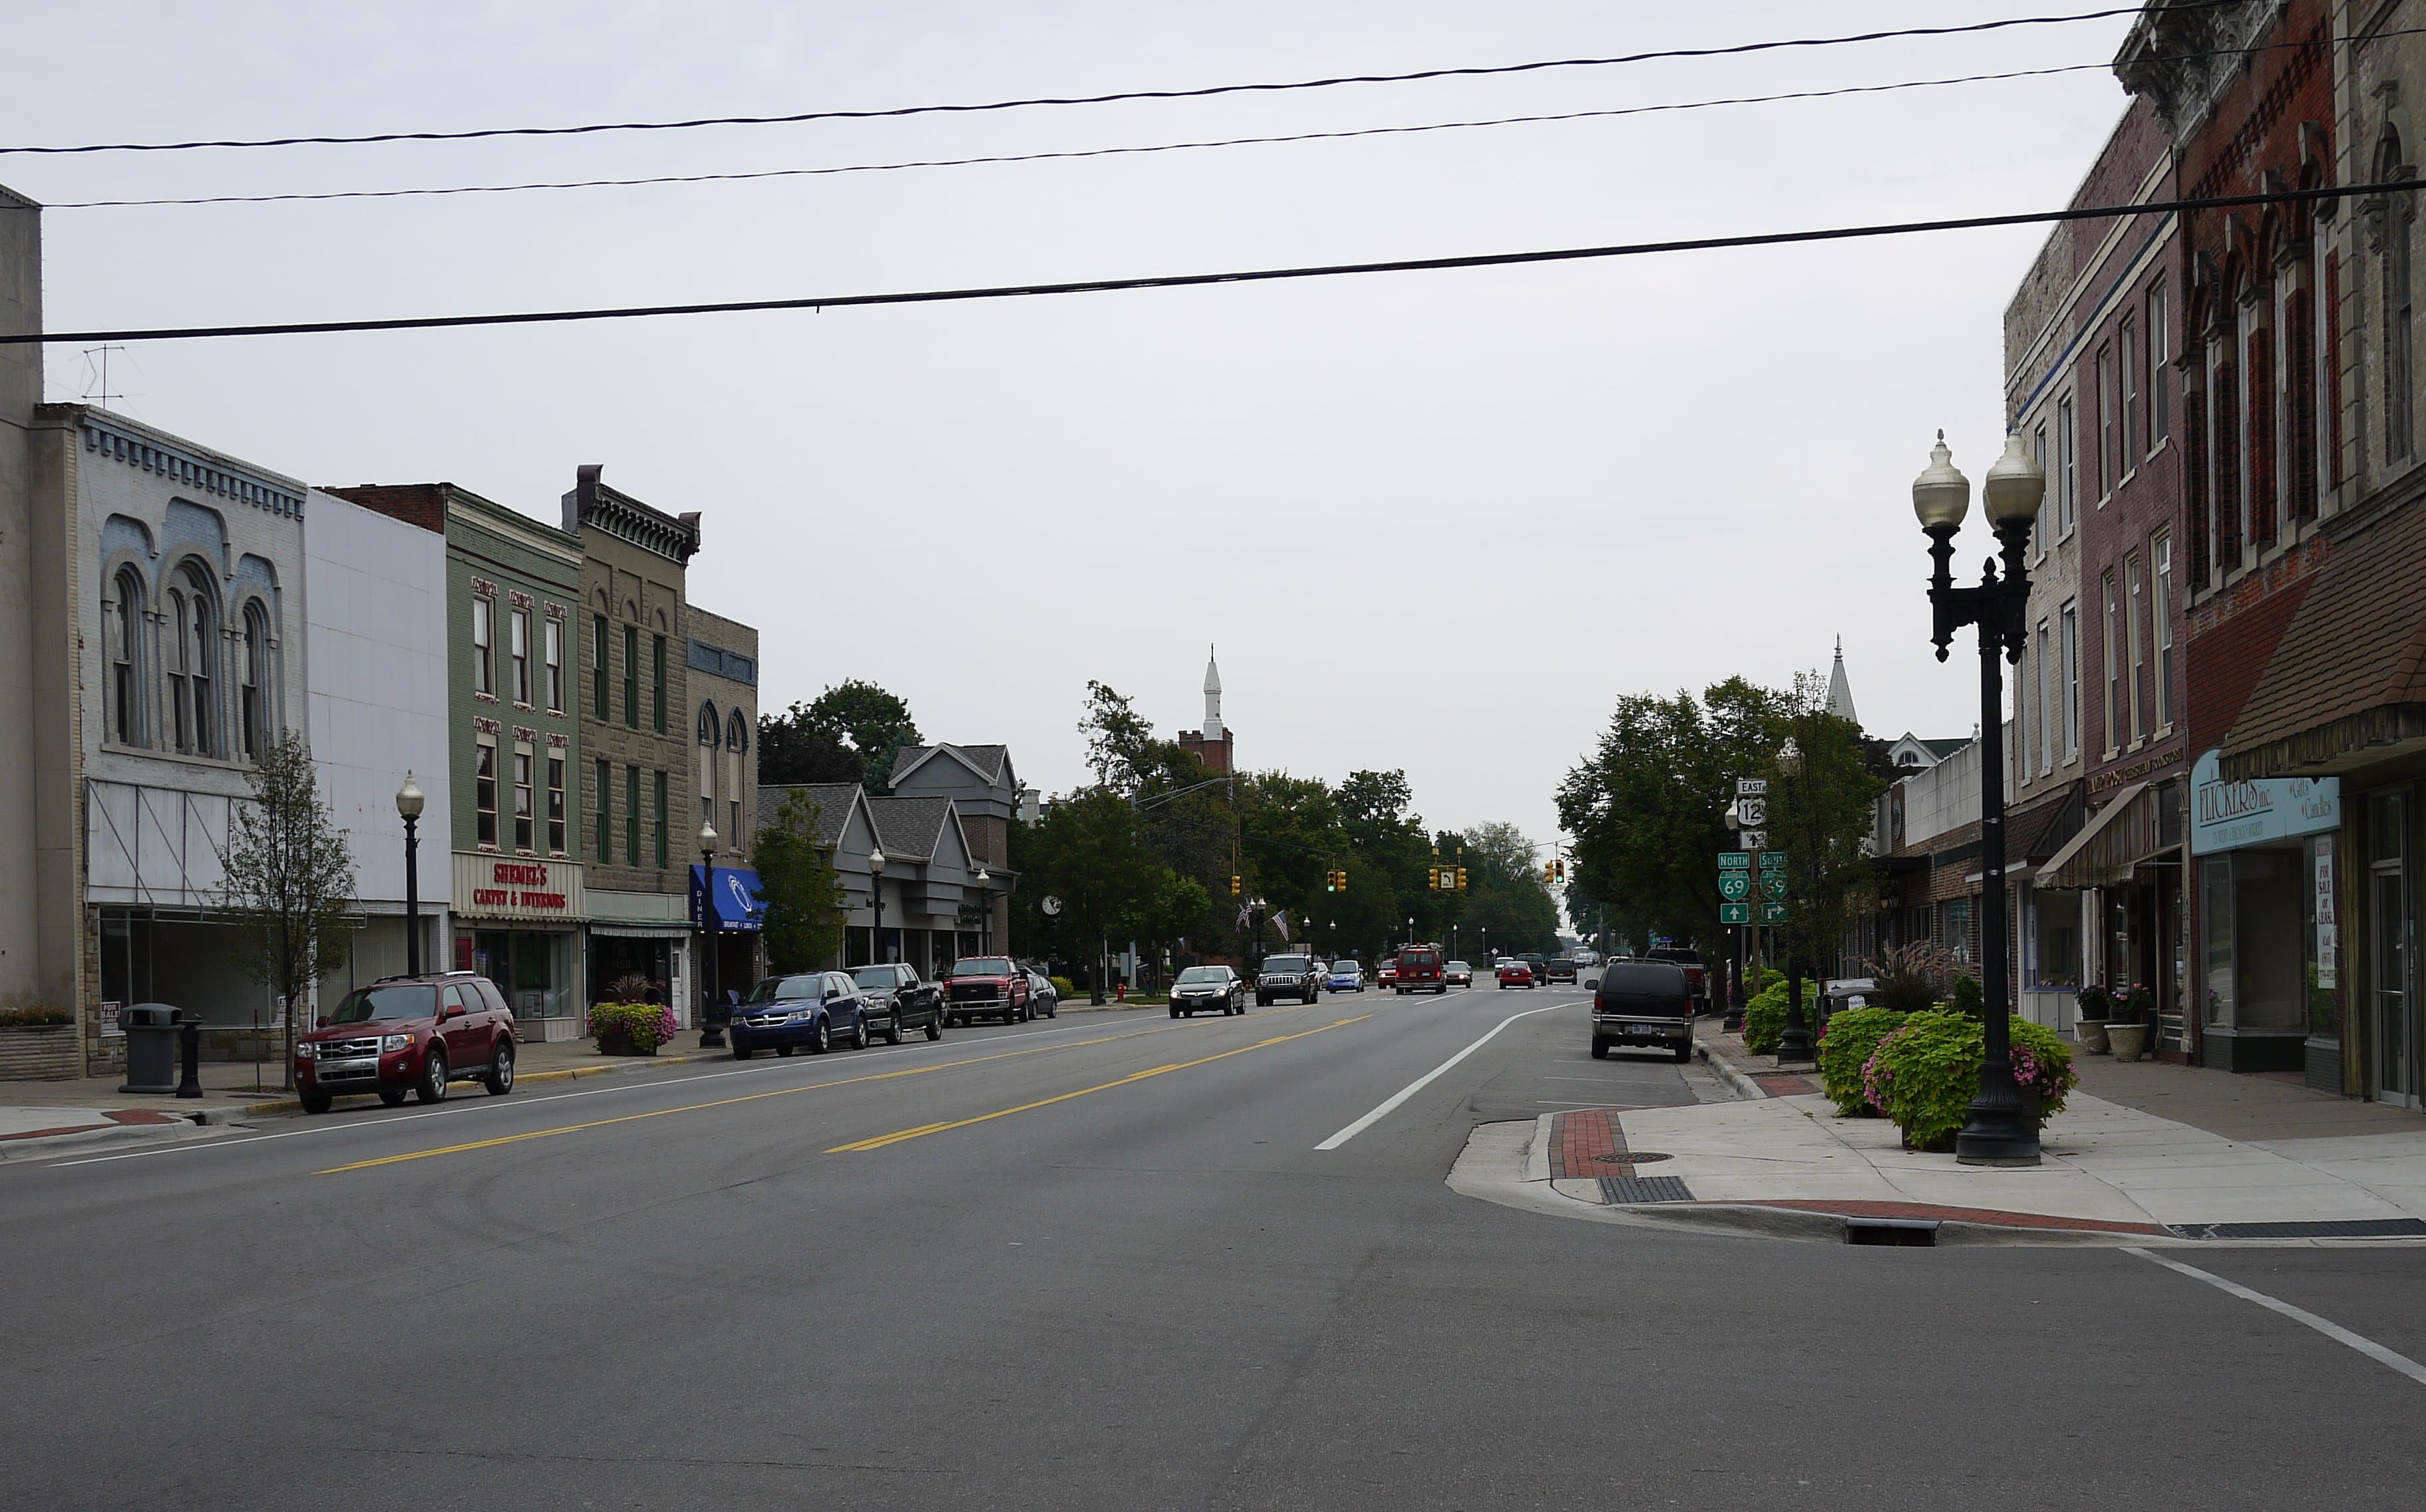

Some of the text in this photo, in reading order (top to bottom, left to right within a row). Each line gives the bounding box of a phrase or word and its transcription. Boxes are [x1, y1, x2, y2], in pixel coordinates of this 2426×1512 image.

[1742, 782, 1763, 792] EAST
[2199, 780, 2258, 822] FLICKERS
[2305, 792, 2332, 820] Candles
[1743, 804, 1761, 820] 12
[1720, 855, 1748, 866] NORTH
[494, 862, 547, 885] SHEMEL'S
[2320, 864, 2330, 879] FOR
[1725, 879, 1744, 895] 69
[2318, 880, 2331, 895] SALE
[474, 889, 566, 909] CARPET & INTERIORS
